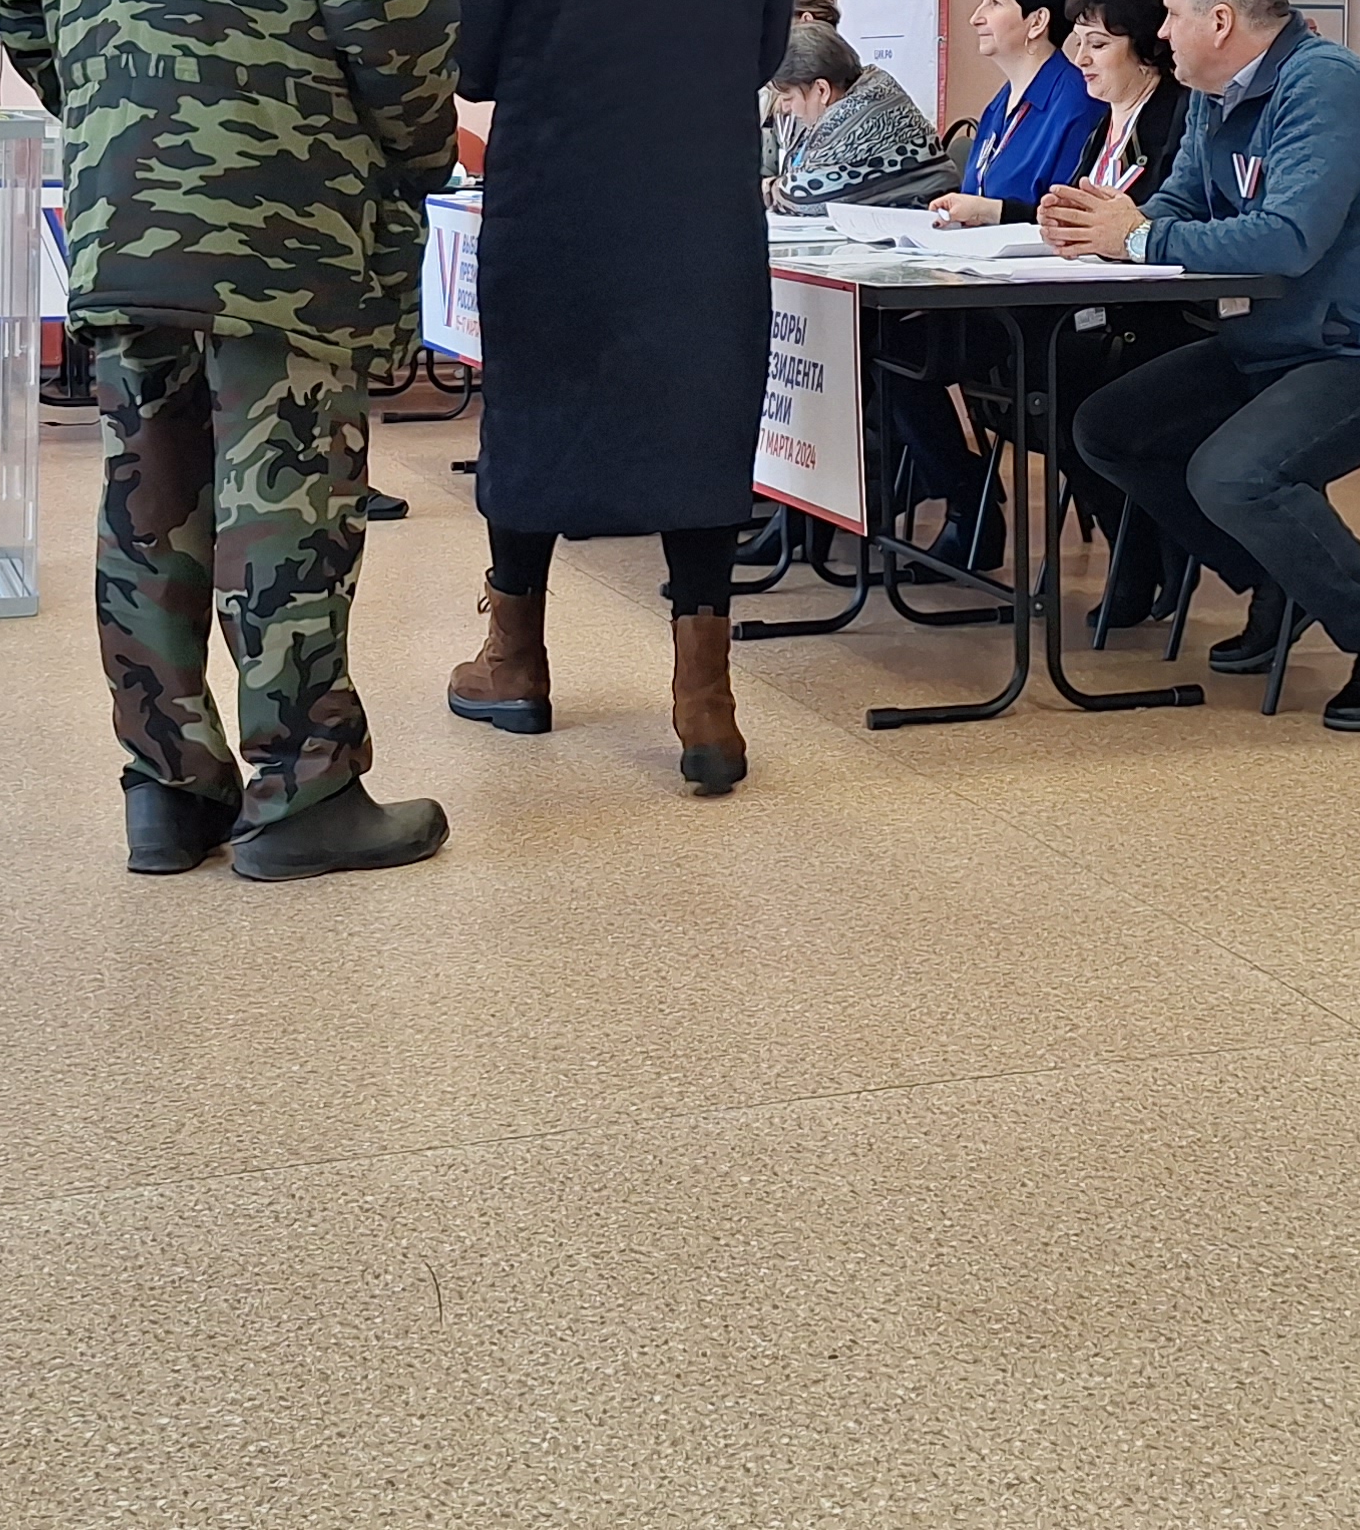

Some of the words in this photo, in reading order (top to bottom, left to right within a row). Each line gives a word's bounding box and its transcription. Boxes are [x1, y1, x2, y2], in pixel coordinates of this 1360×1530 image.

[771, 311, 807, 346] БОРЫ
[769, 351, 824, 393] ЗИДЕНТА
[762, 392, 793, 425] ССИИ
[766, 431, 794, 463] МАРТА
[795, 440, 817, 470] 2024
